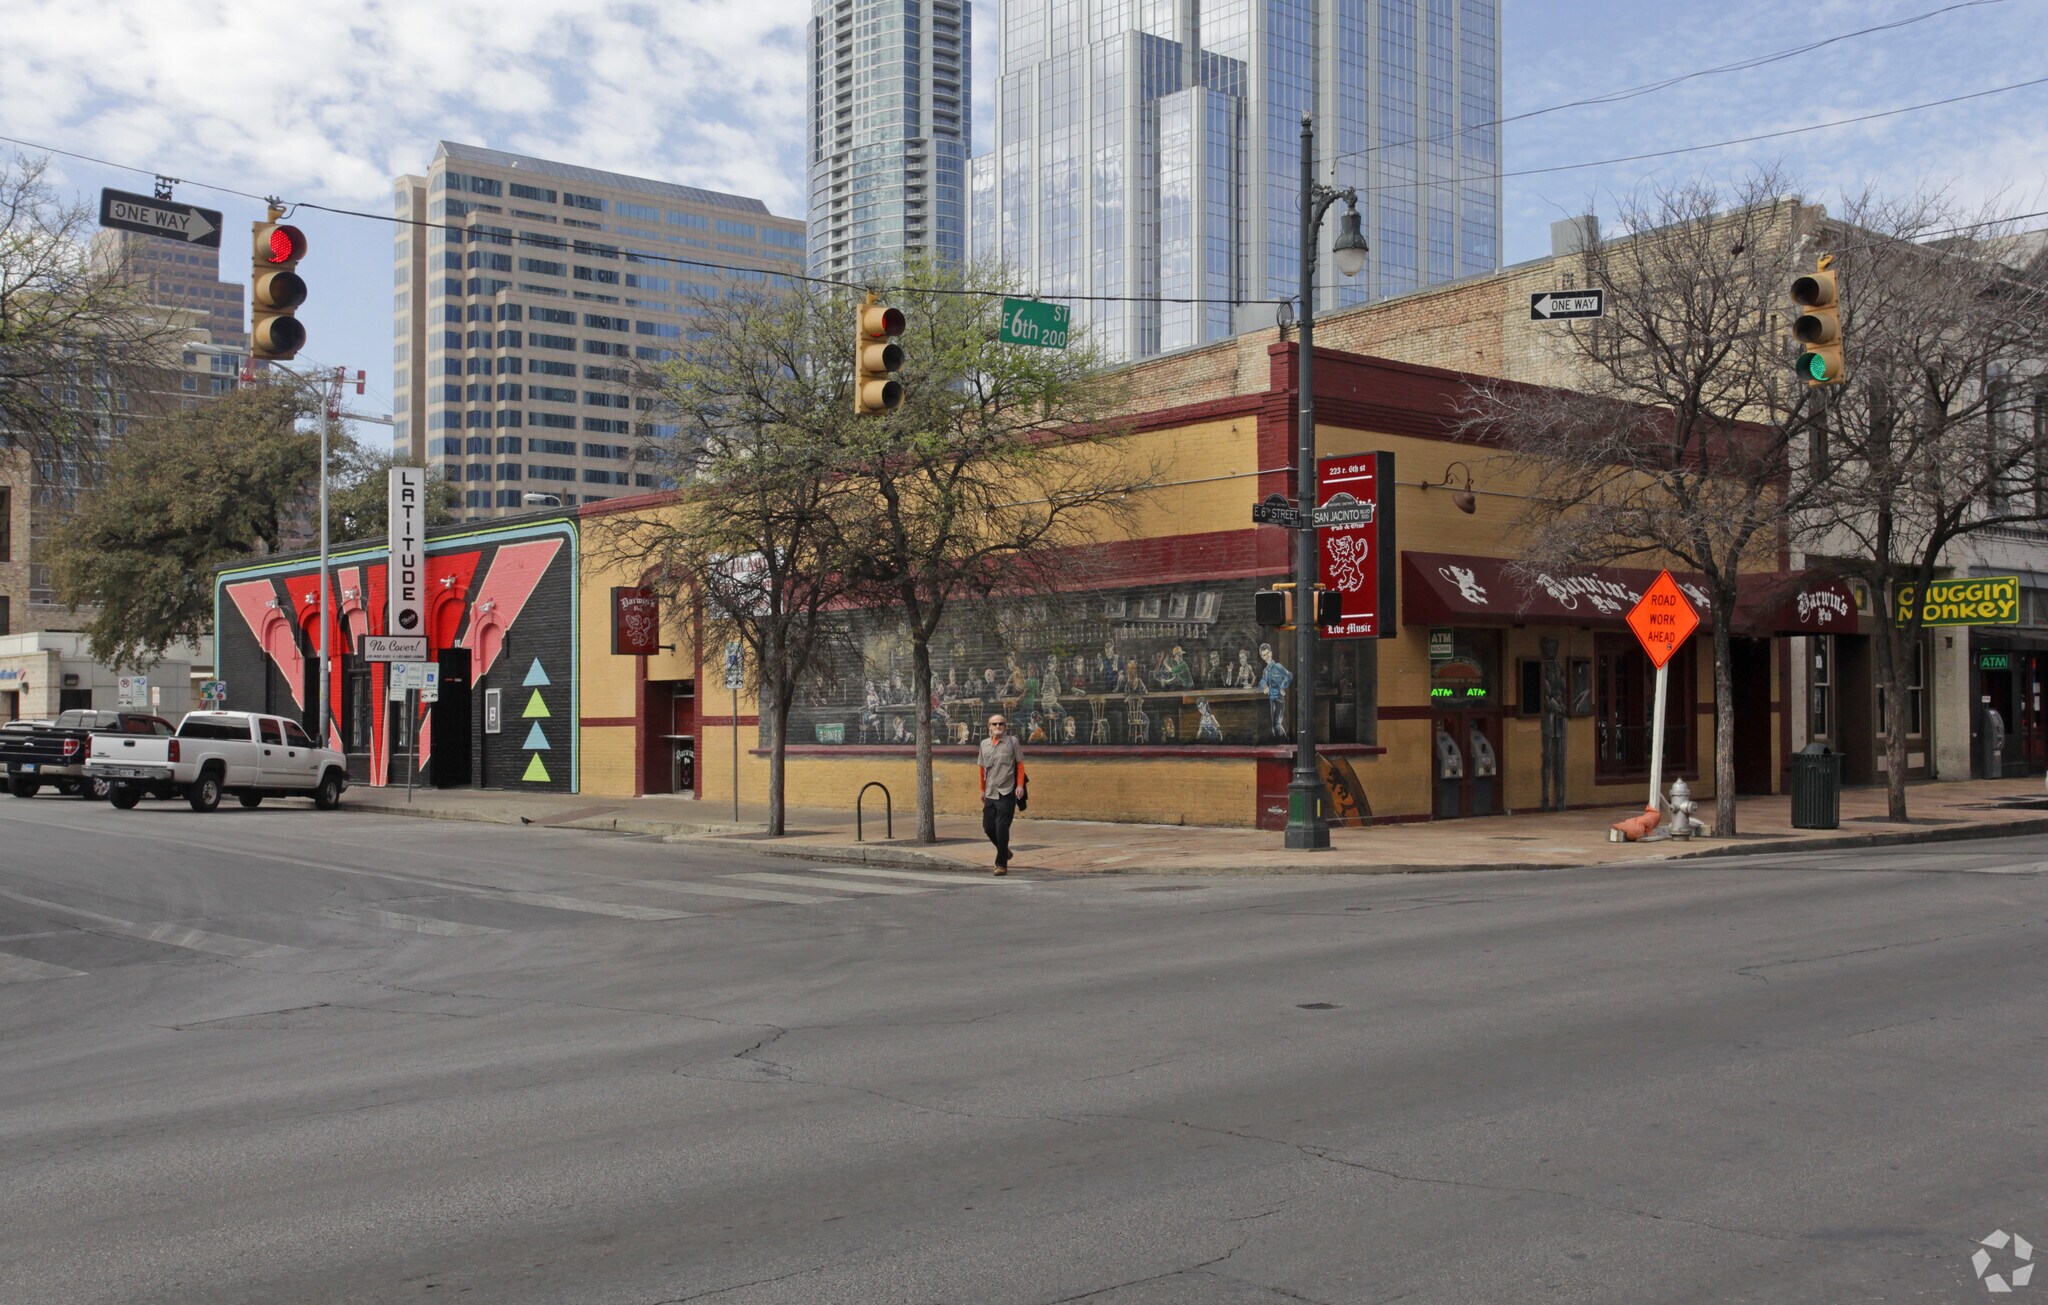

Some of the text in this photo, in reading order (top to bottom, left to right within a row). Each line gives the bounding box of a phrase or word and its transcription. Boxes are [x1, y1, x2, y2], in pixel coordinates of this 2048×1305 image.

[115, 203, 190, 230] ONE WAY
[1551, 298, 1595, 311] ONE WAY
[1053, 306, 1069, 323] ST
[1002, 306, 1066, 347] E 6th 200
[1329, 466, 1341, 476] 223
[1271, 508, 1299, 520] STREET
[1314, 512, 1329, 523] SAN
[1330, 509, 1360, 522] JACINTO
[402, 471, 416, 601] LATITUDE
[1536, 572, 1642, 610] Darwin's
[1586, 594, 1622, 614] Pub
[1651, 594, 1677, 606] ROAD
[1796, 586, 1848, 623] Darwin's
[1650, 614, 1676, 625] WORK
[1818, 607, 1832, 625] Pub
[1327, 622, 1371, 634] Live Music
[1431, 633, 1451, 643] ATM
[1647, 631, 1676, 643] AHEAD
[369, 639, 421, 652] No Cover!
[1982, 656, 2006, 667] ATM
[1431, 688, 1486, 697] ATM ATM
